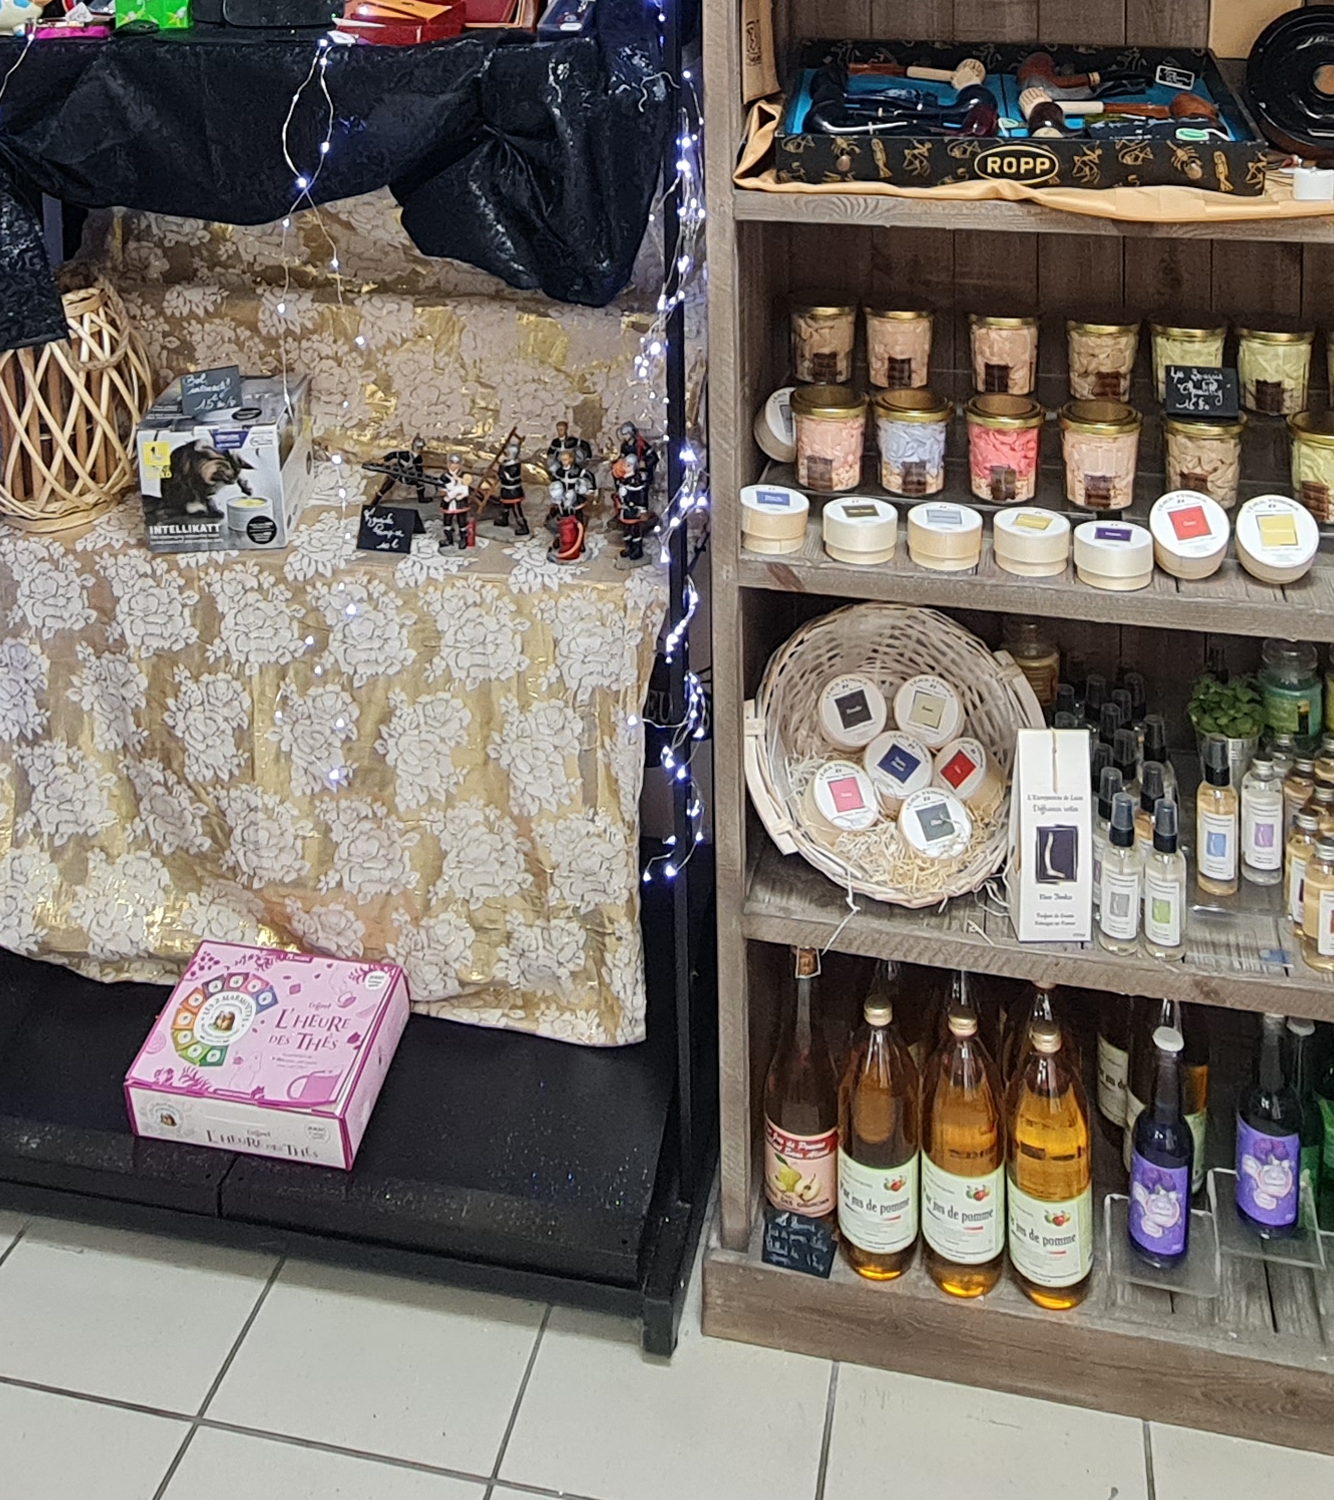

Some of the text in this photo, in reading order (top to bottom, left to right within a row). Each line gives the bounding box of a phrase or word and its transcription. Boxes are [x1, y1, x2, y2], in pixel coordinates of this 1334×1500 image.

[984, 156, 1052, 177] ROPP
[149, 524, 222, 537] INTELLIKATT
[275, 1007, 352, 1032] L'HEURE
[268, 1032, 340, 1052] DES THÉS
[206, 1129, 262, 1149] L'HEURE
[850, 1190, 864, 1208] jus
[865, 1197, 878, 1214] de
[879, 1197, 911, 1216] pomme
[932, 1199, 995, 1224] jus de pomme
[1028, 1228, 1077, 1248] de pomme
